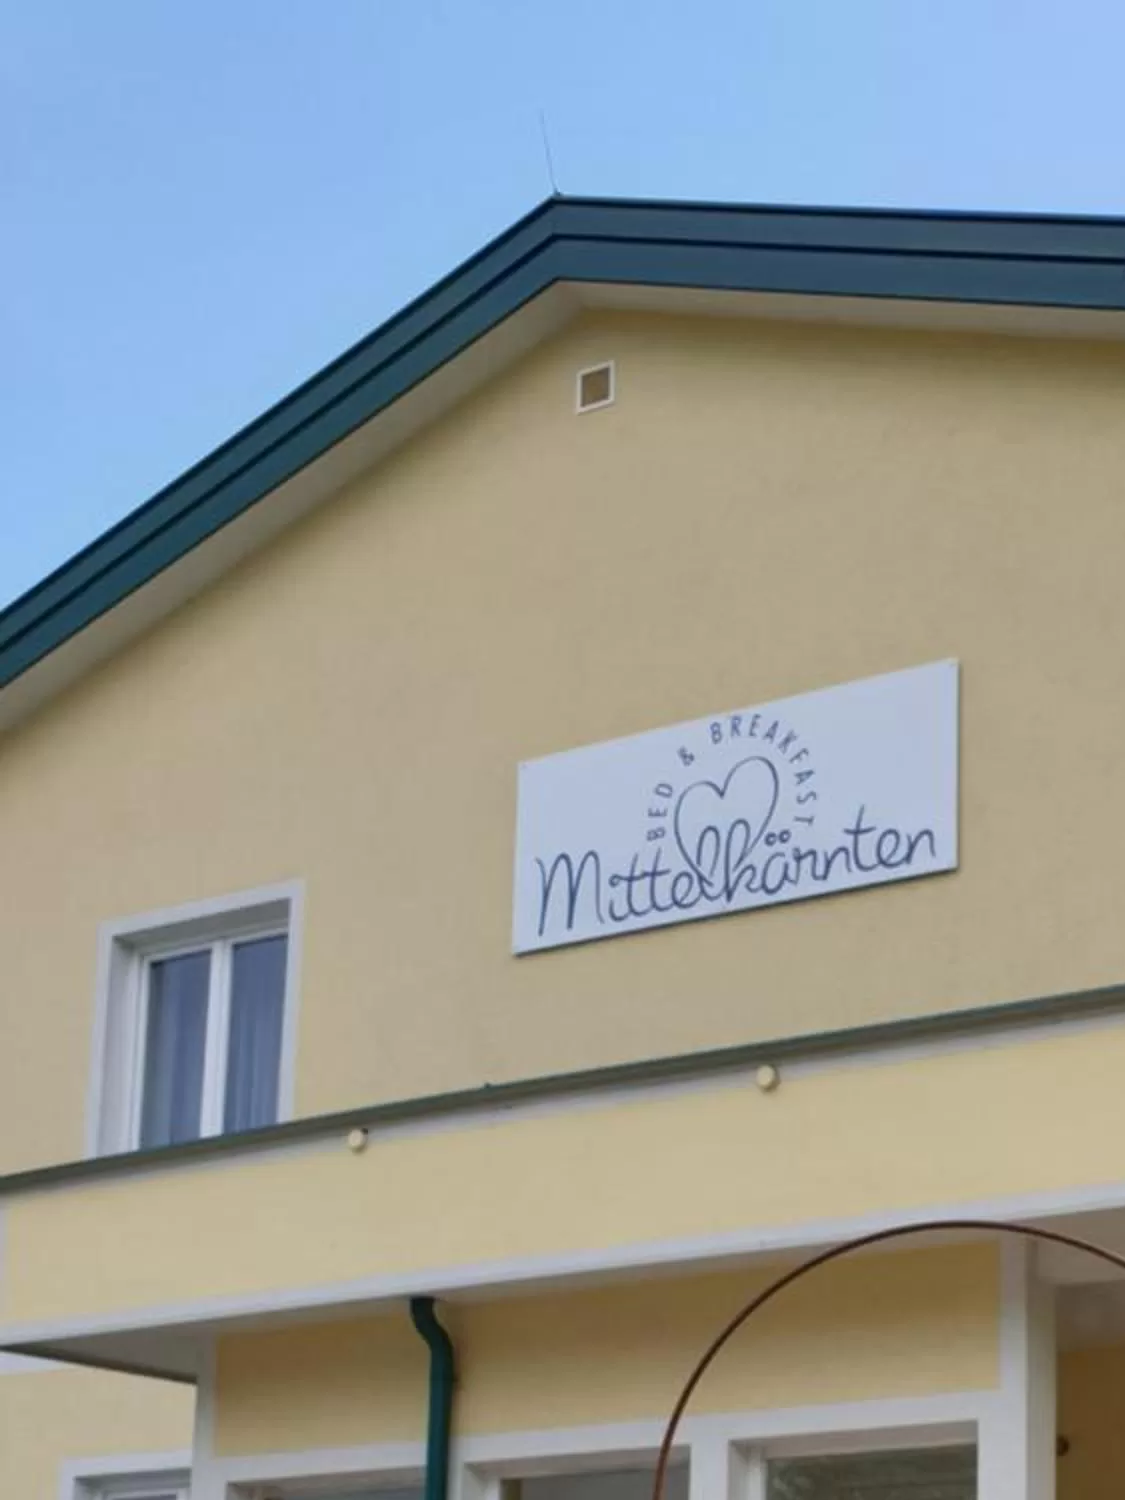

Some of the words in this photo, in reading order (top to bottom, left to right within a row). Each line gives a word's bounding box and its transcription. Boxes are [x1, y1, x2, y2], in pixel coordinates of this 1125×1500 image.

[646, 782, 674, 842] BED
[677, 745, 695, 767] &
[710, 713, 817, 827] BREAKFAST
[535, 804, 937, 936] Mittelkärnten
